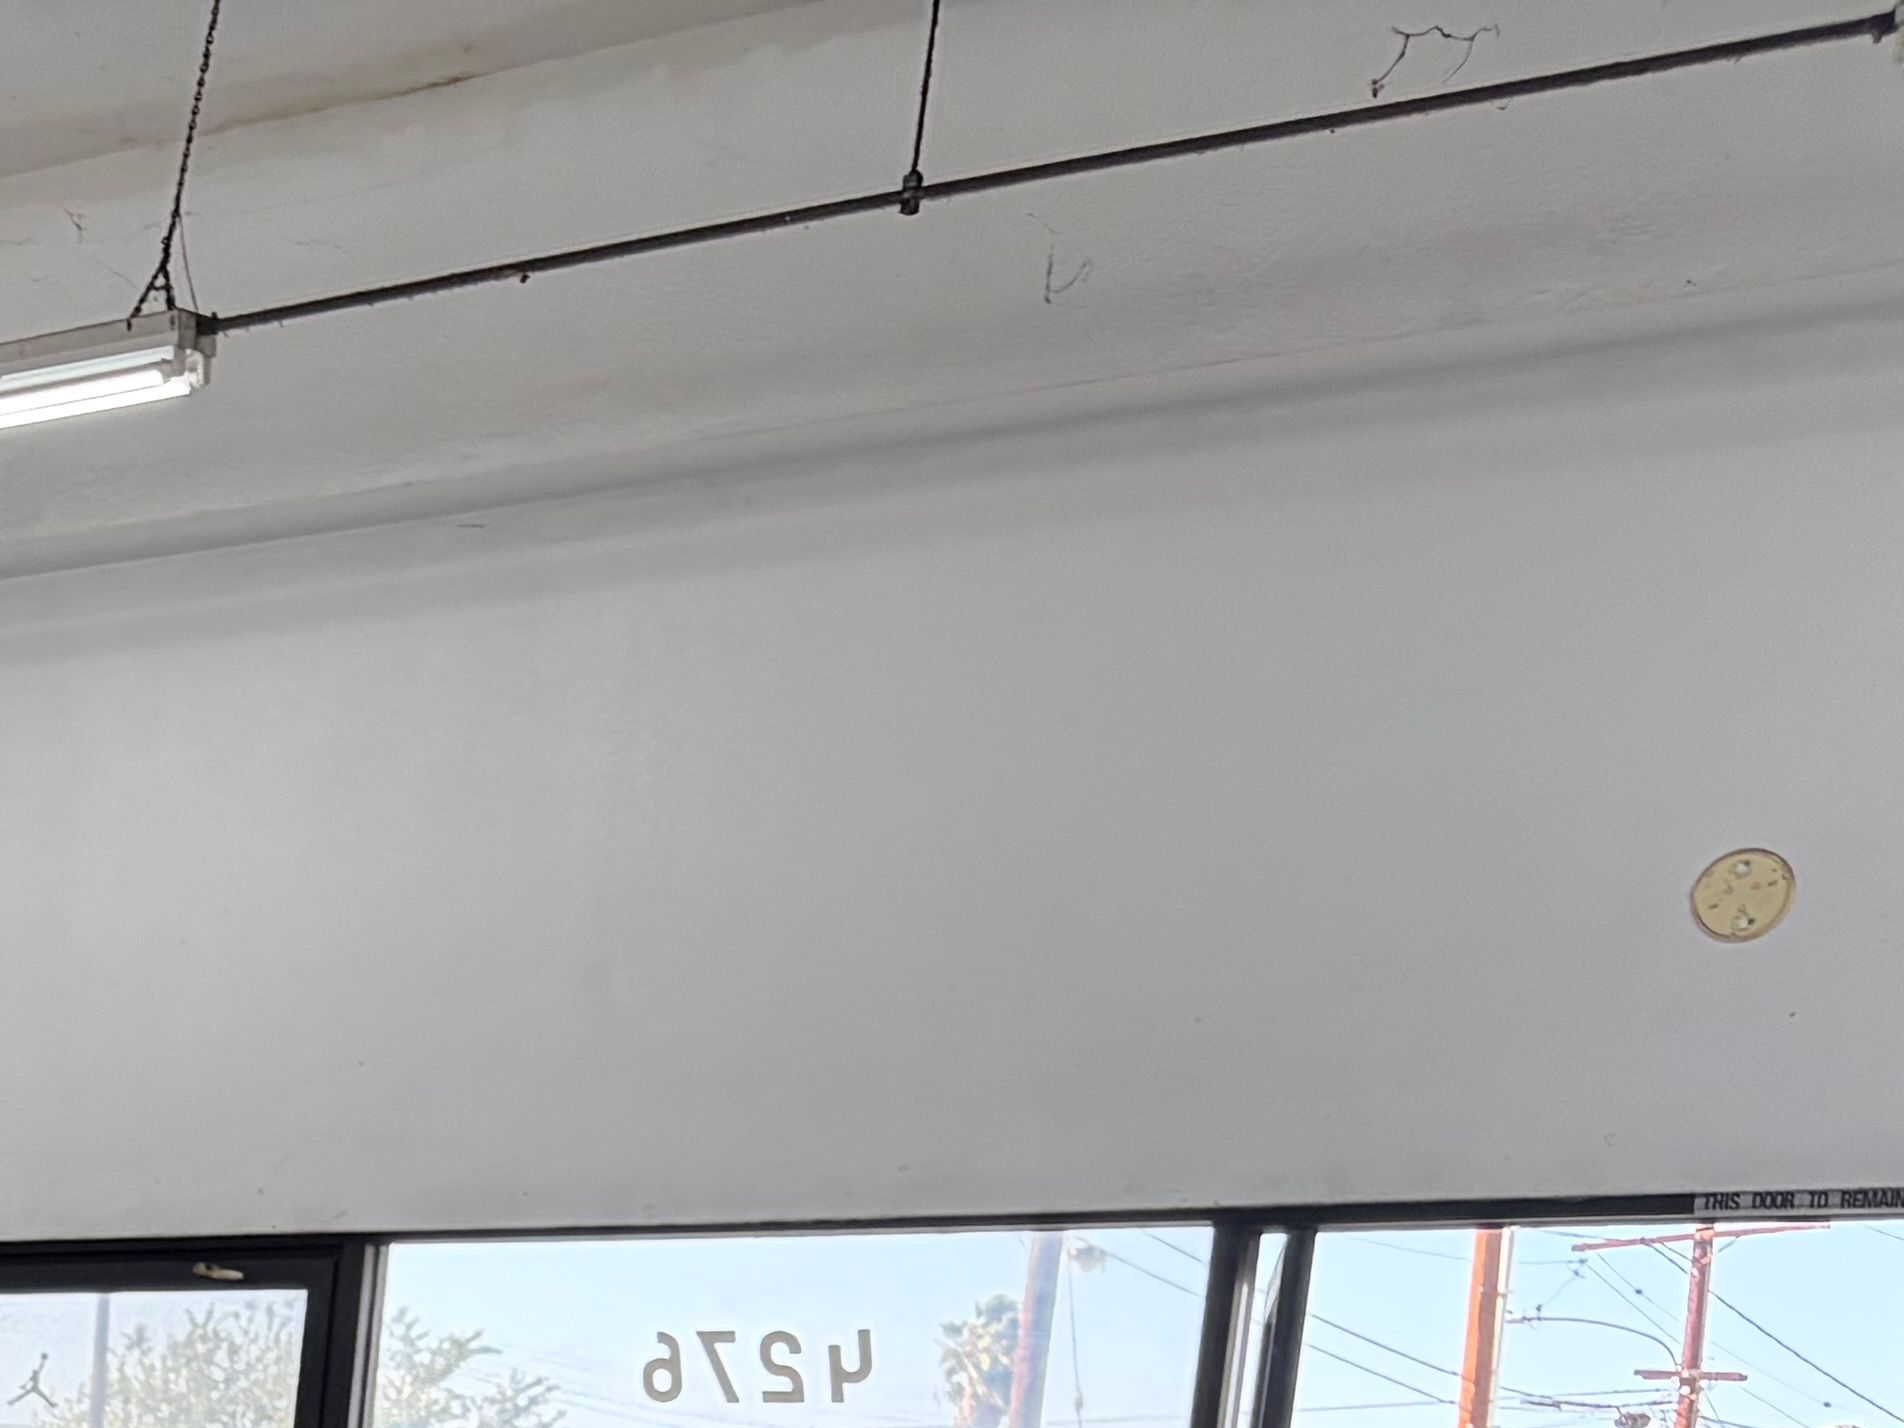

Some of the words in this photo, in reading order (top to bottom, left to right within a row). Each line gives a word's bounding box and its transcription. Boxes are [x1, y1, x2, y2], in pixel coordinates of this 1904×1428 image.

[1704, 1194, 1740, 1209] THIS
[1752, 1191, 1794, 1209] DOOR
[1809, 1191, 1828, 1208] TO
